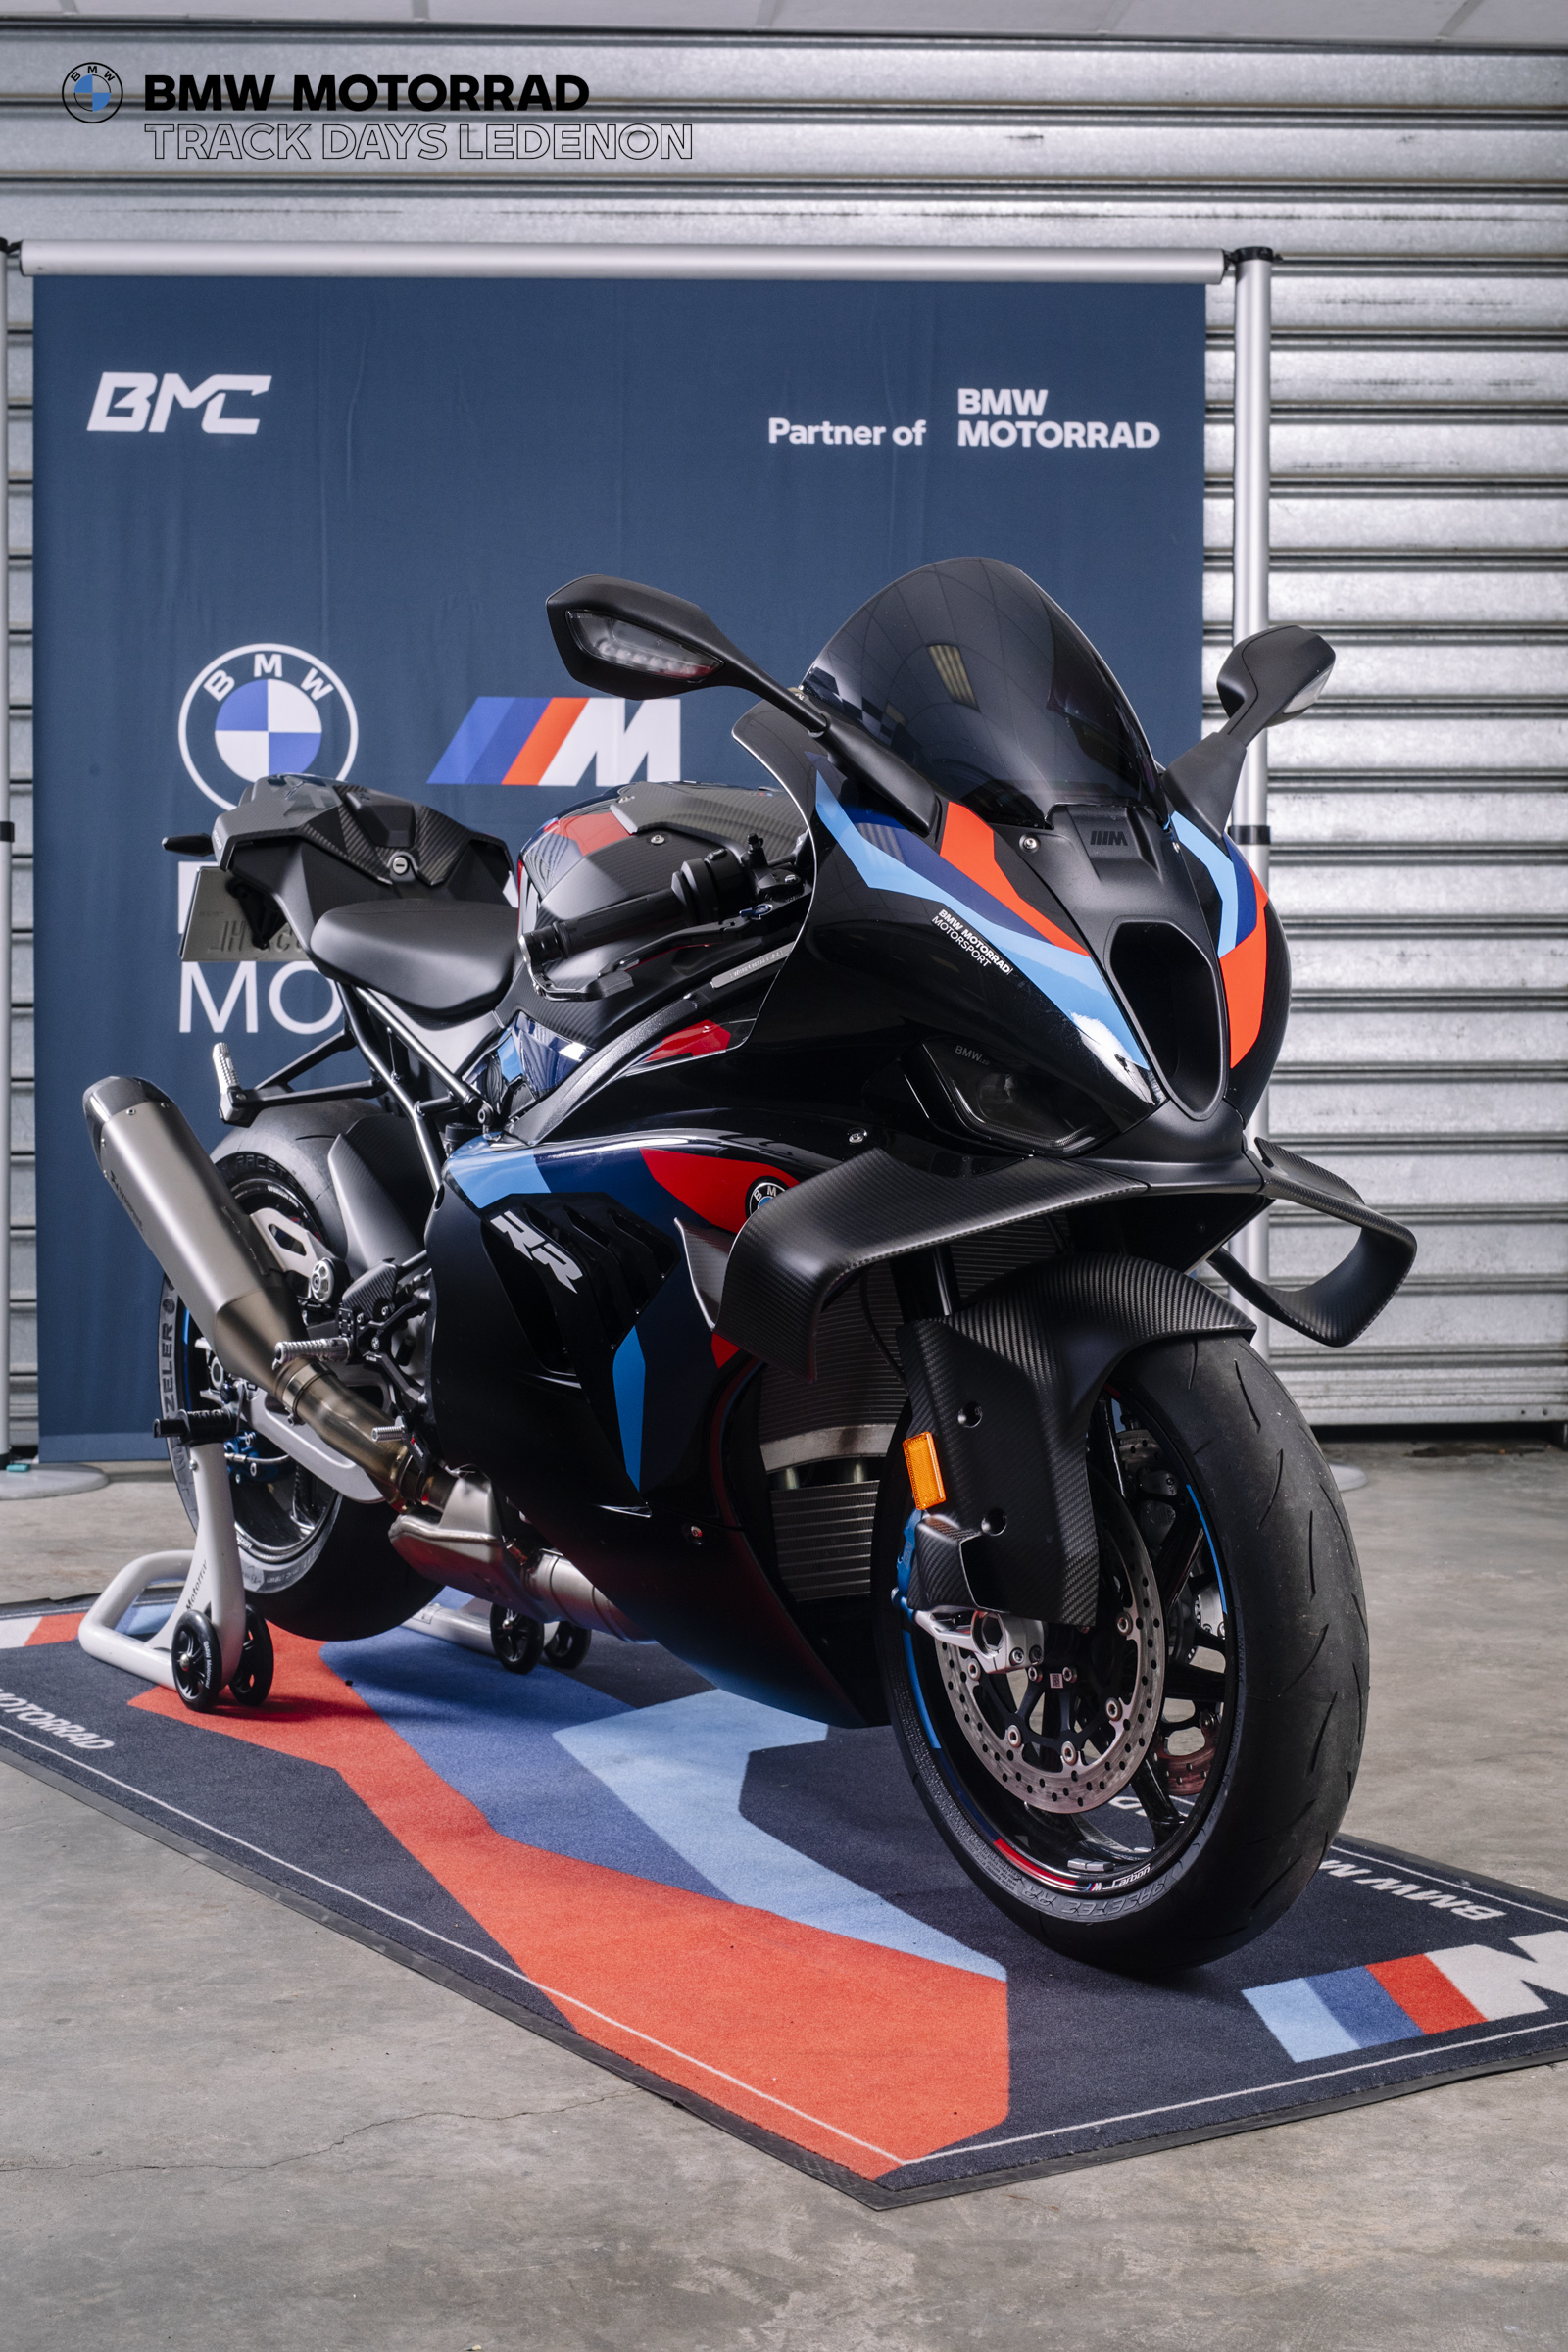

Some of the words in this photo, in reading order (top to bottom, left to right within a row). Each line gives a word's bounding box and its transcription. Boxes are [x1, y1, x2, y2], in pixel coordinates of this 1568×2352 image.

[86, 371, 272, 434] BMC
[957, 388, 1049, 416] BMW
[768, 417, 886, 445] Partner
[892, 419, 927, 446] of
[957, 420, 1160, 448] MOTORRAD
[203, 653, 334, 702] BMW
[932, 915, 992, 967] MOTORSPORT
[938, 908, 964, 931] BMW
[961, 928, 1011, 974] MOTORRAD
[955, 1045, 983, 1062] BMW
[490, 1210, 583, 1294] RR
[161, 1322, 176, 1420] ZELER
[202, 1641, 212, 1657] BMW
[1105, 1863, 1152, 1889] Carbon
[1352, 1877, 1508, 1921] BMW
